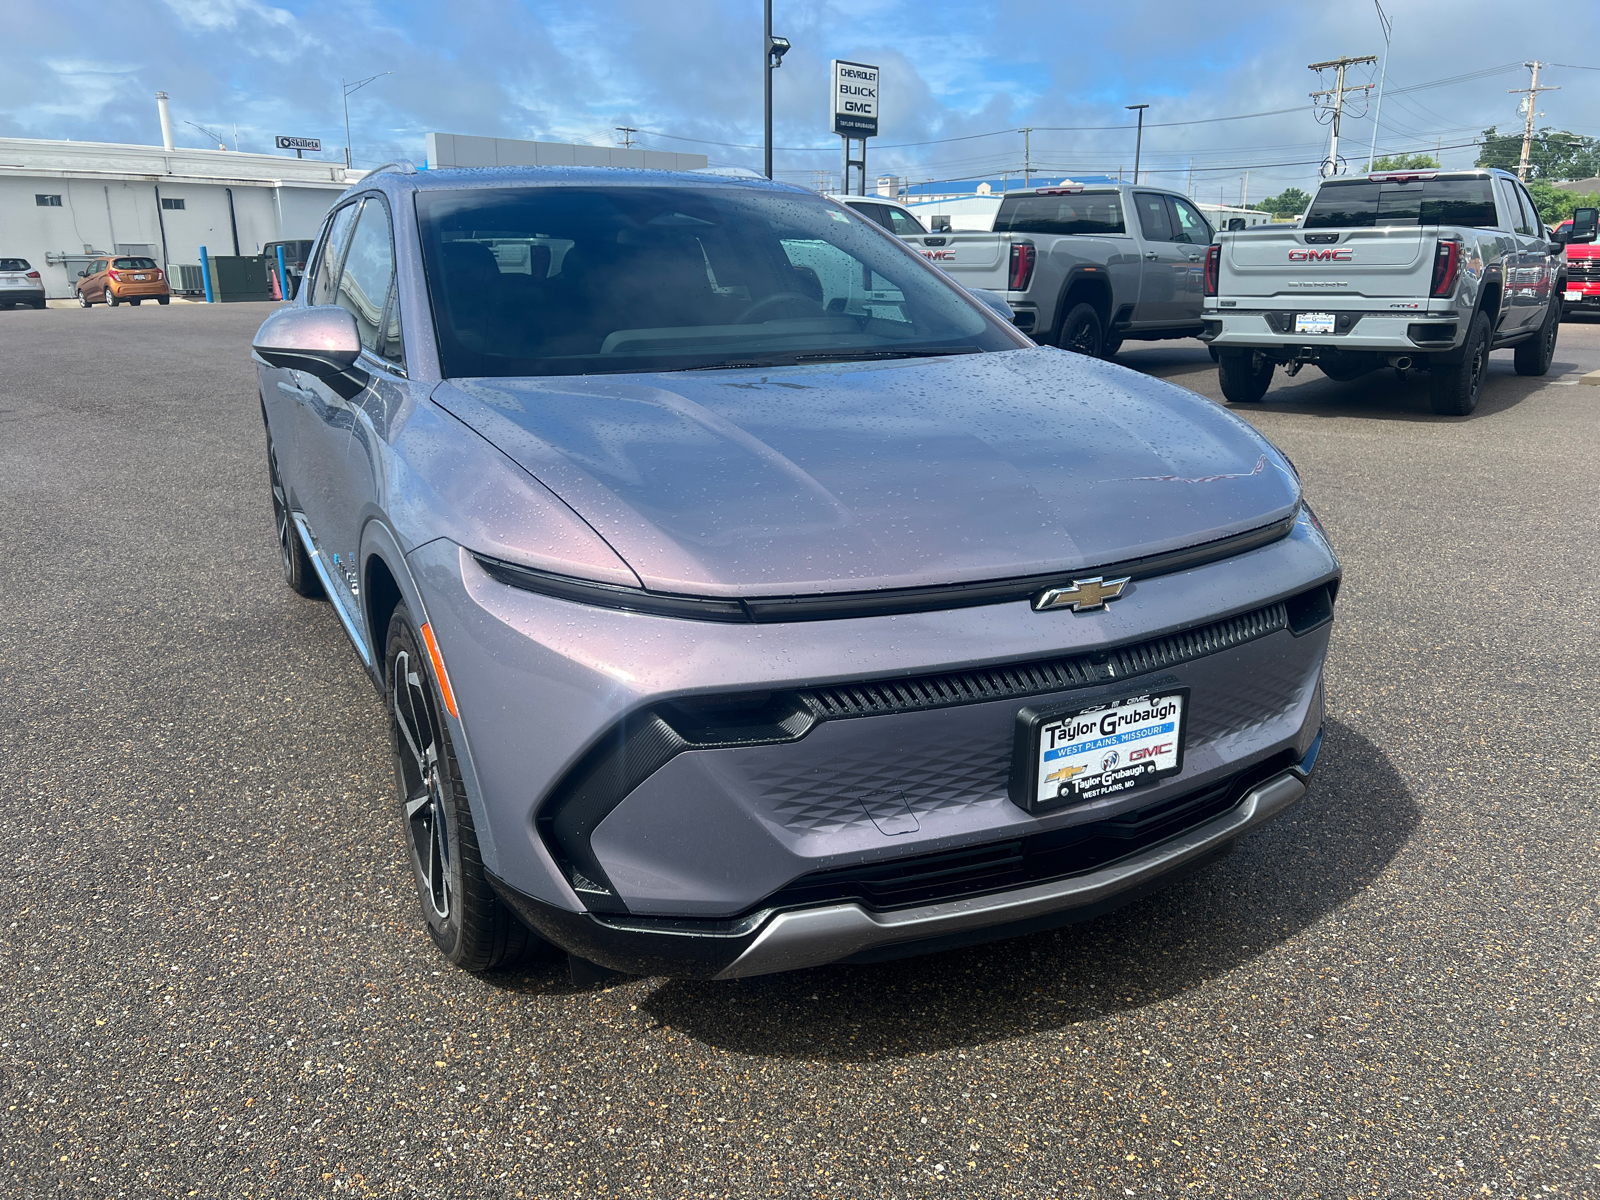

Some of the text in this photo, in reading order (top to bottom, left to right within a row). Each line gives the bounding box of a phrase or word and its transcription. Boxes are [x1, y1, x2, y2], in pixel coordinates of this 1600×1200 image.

[841, 68, 877, 81] CHEVROLET
[840, 84, 876, 98] BUICK
[845, 101, 872, 114] GMC
[290, 138, 319, 148] Skillets
[1289, 248, 1353, 261] GMC
[1045, 702, 1176, 748] Taylor Grubaugh
[1057, 725, 1162, 757] WEST PLAINS, MISSOURI
[1129, 742, 1173, 762] GMC
[1072, 765, 1145, 794] Taylor Grubaugh
[1082, 779, 1135, 799] WEST PLAINS, MO
